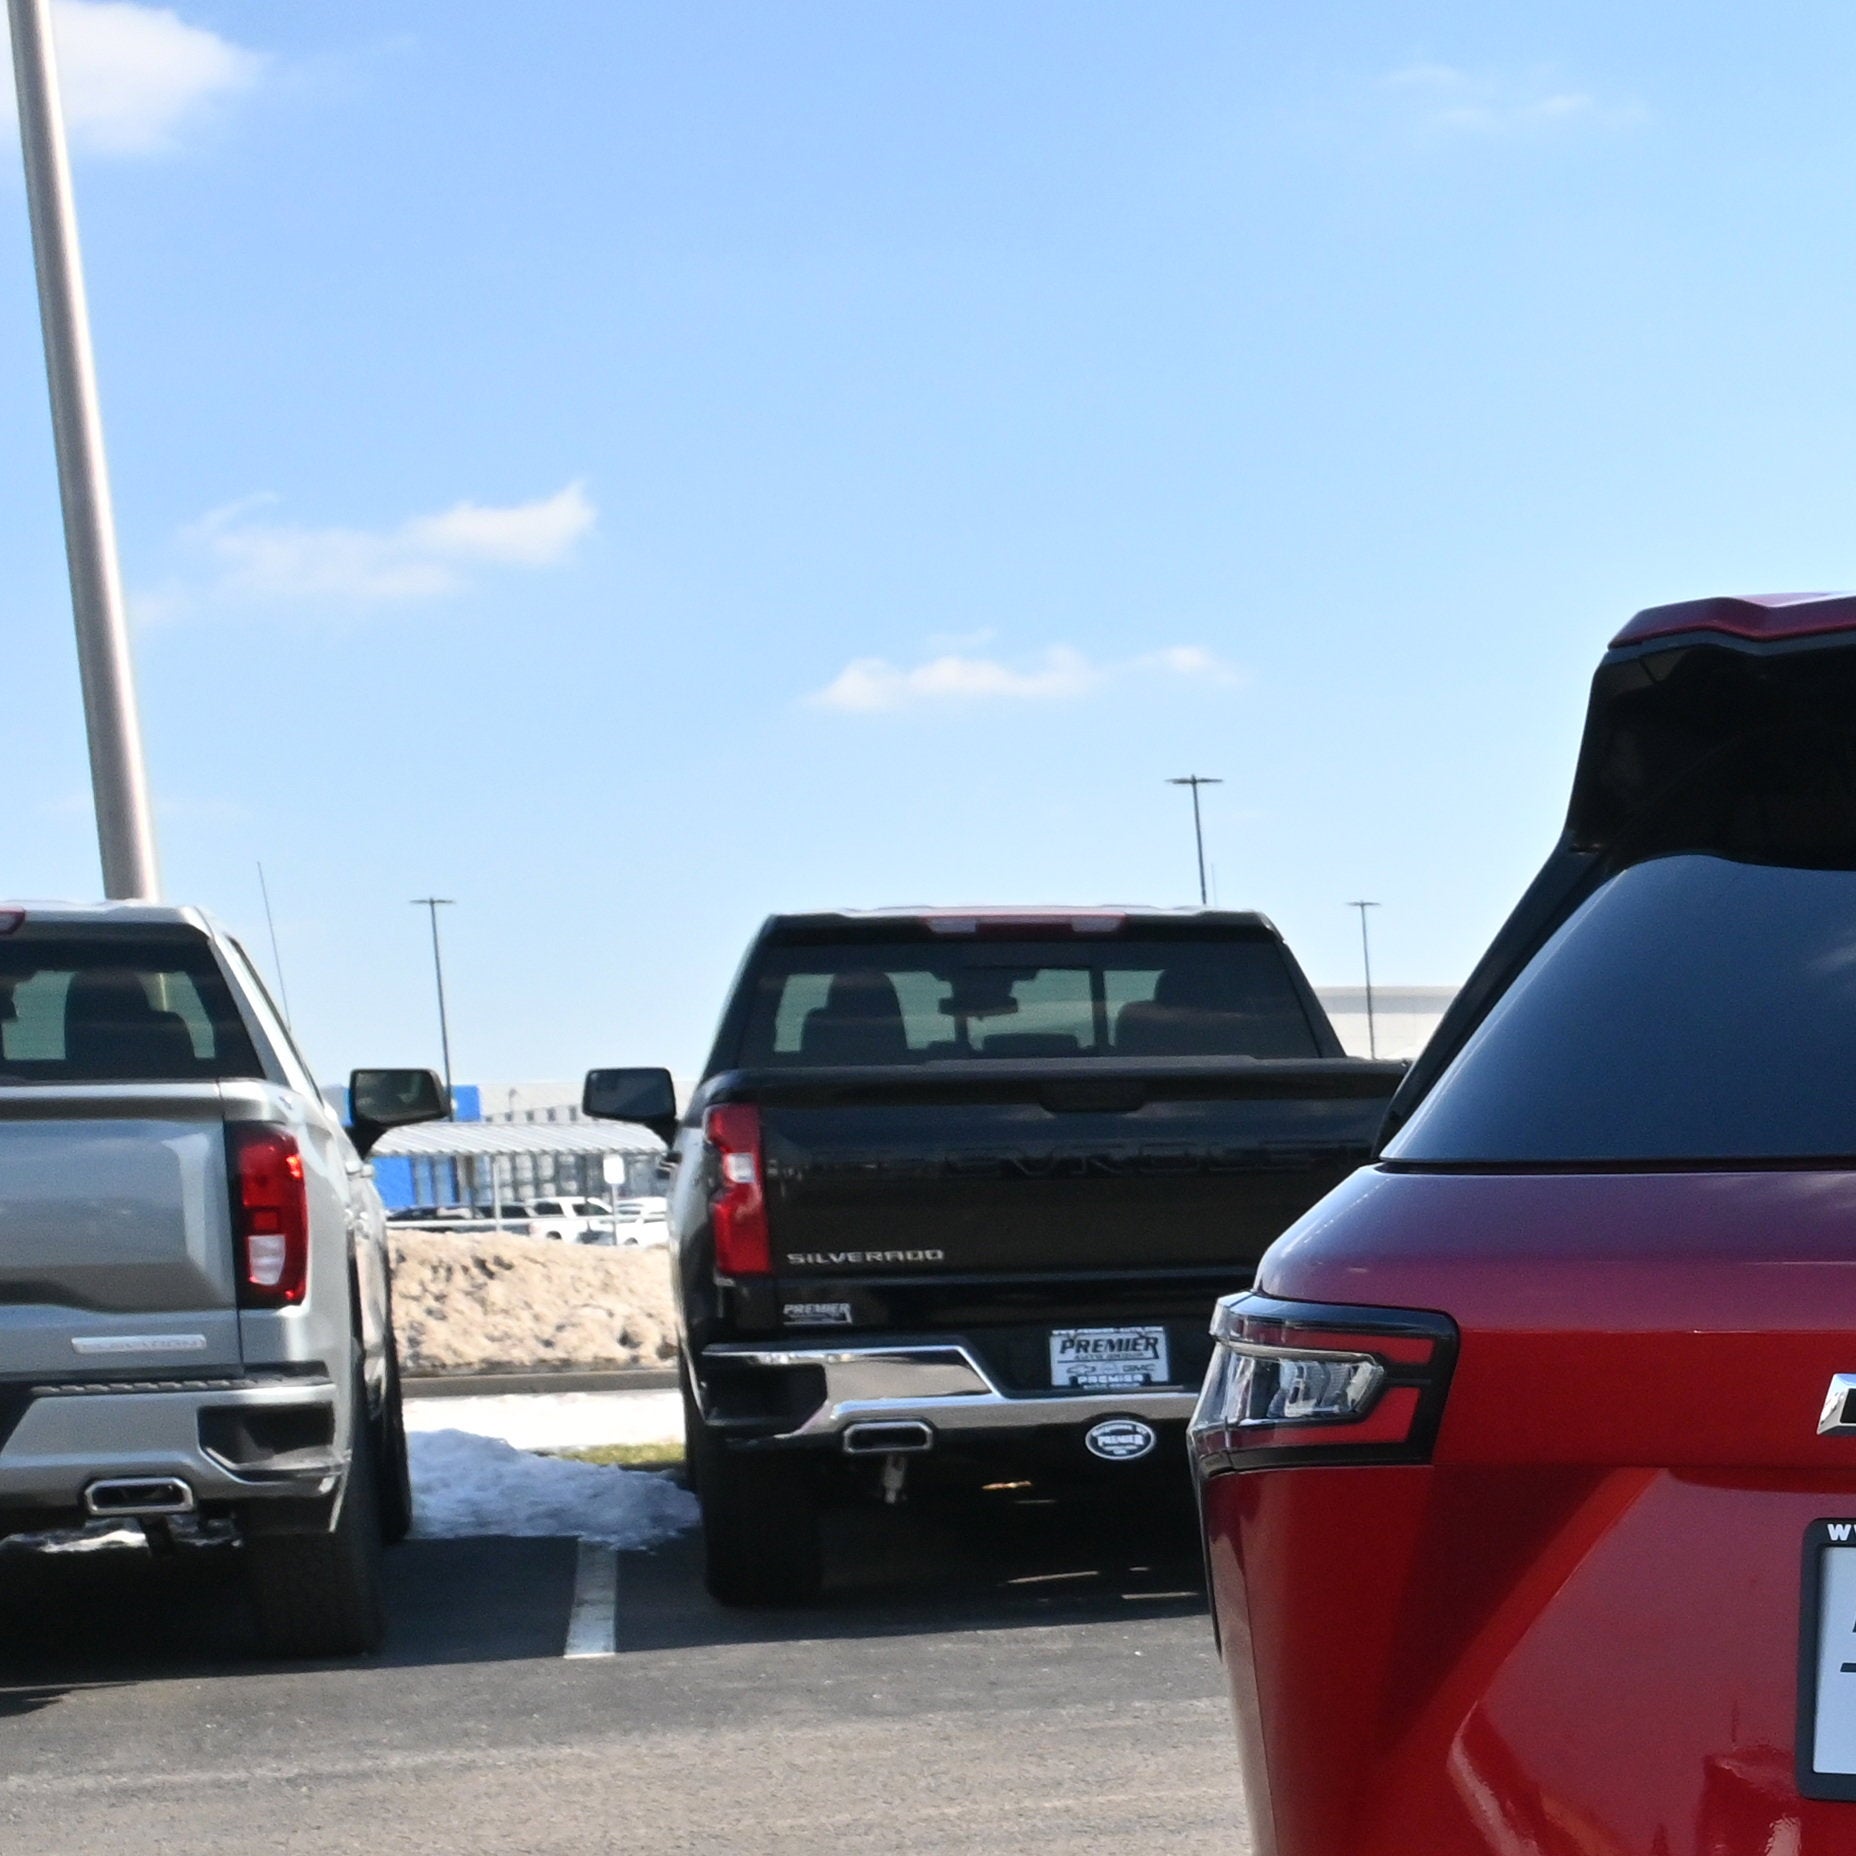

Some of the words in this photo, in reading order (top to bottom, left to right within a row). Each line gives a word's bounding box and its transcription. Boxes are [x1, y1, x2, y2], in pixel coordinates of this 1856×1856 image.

[786, 1249, 945, 1264] SILVERADO
[783, 1303, 851, 1317] PREMIER
[1059, 1336, 1159, 1357] PREMIER
